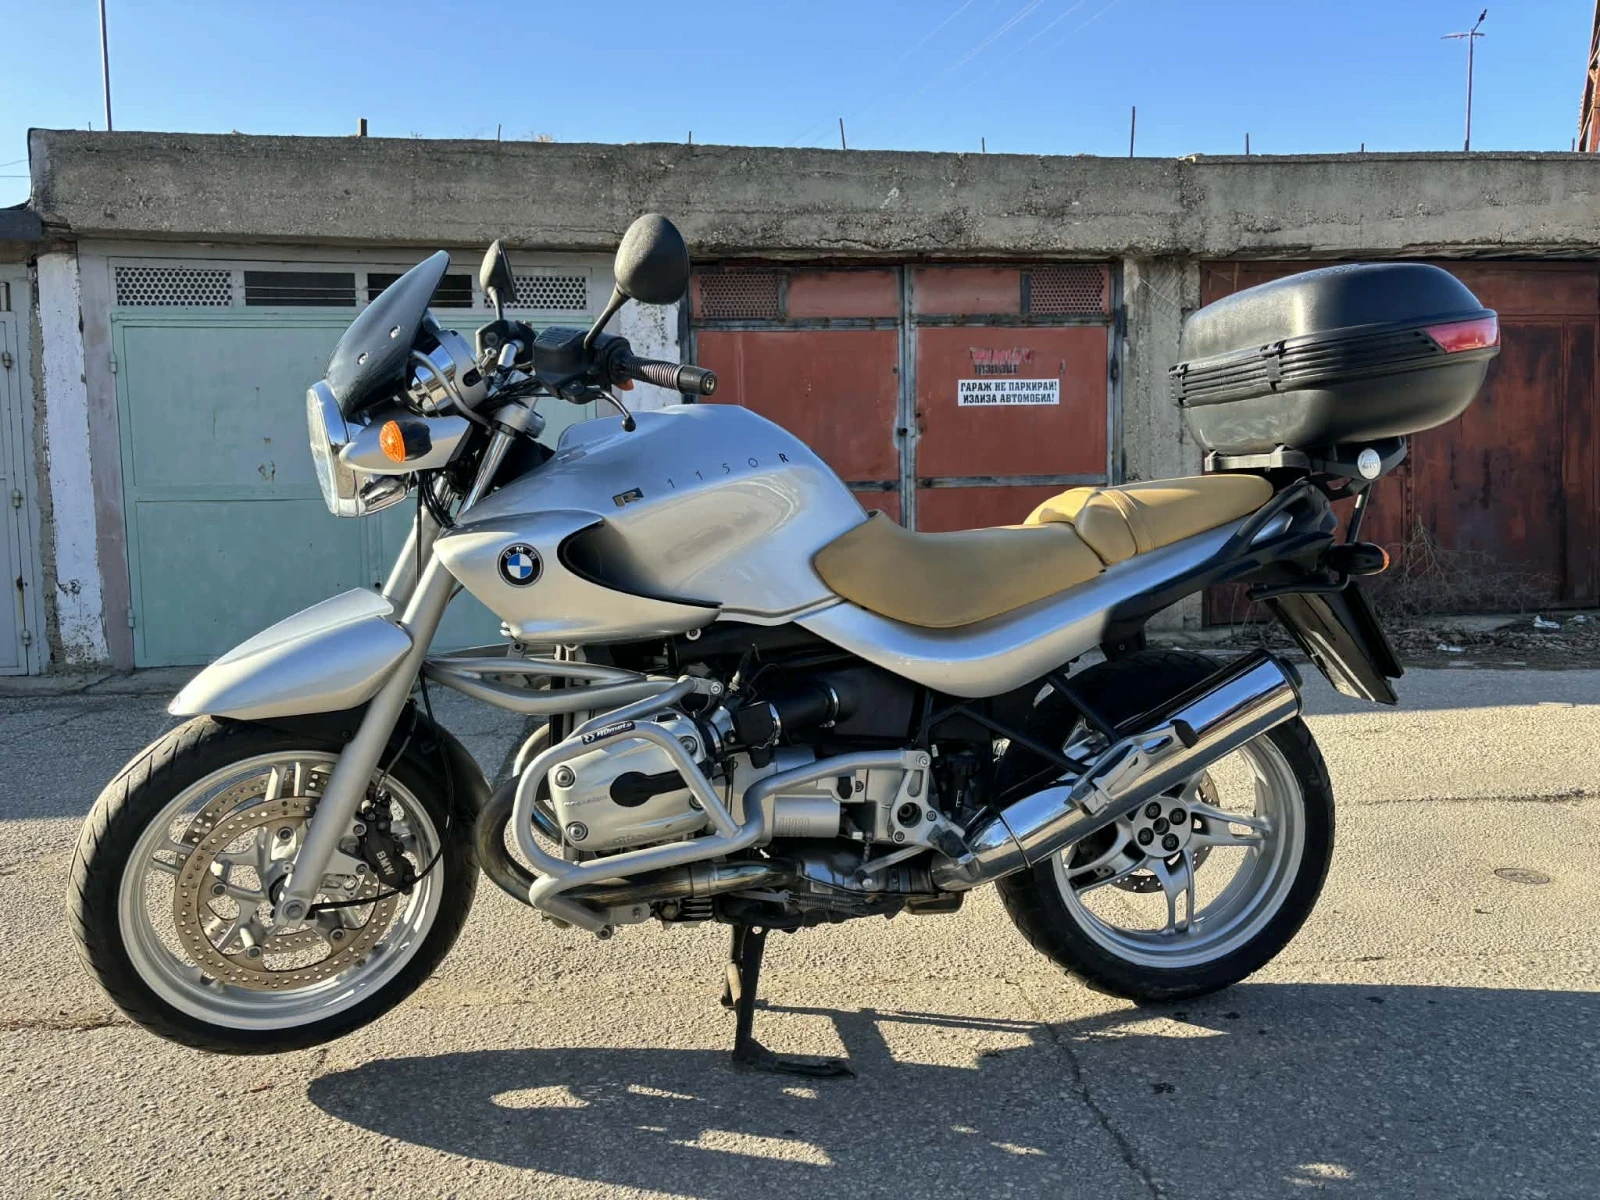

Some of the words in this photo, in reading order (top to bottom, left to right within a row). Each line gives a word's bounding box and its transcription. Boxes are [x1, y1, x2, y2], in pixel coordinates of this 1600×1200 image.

[960, 382, 992, 392] ГАРАЖ
[995, 382, 1007, 391] НЕ
[1009, 381, 1057, 391] ПАРКИРАЙ!
[963, 394, 997, 404] ИЗЛИЗА
[1000, 393, 1055, 403] АВТОМОБИЛ!
[667, 457, 759, 489] 1150
[778, 453, 790, 464] R
[503, 546, 538, 560] BMW
[376, 850, 395, 876] BMW
